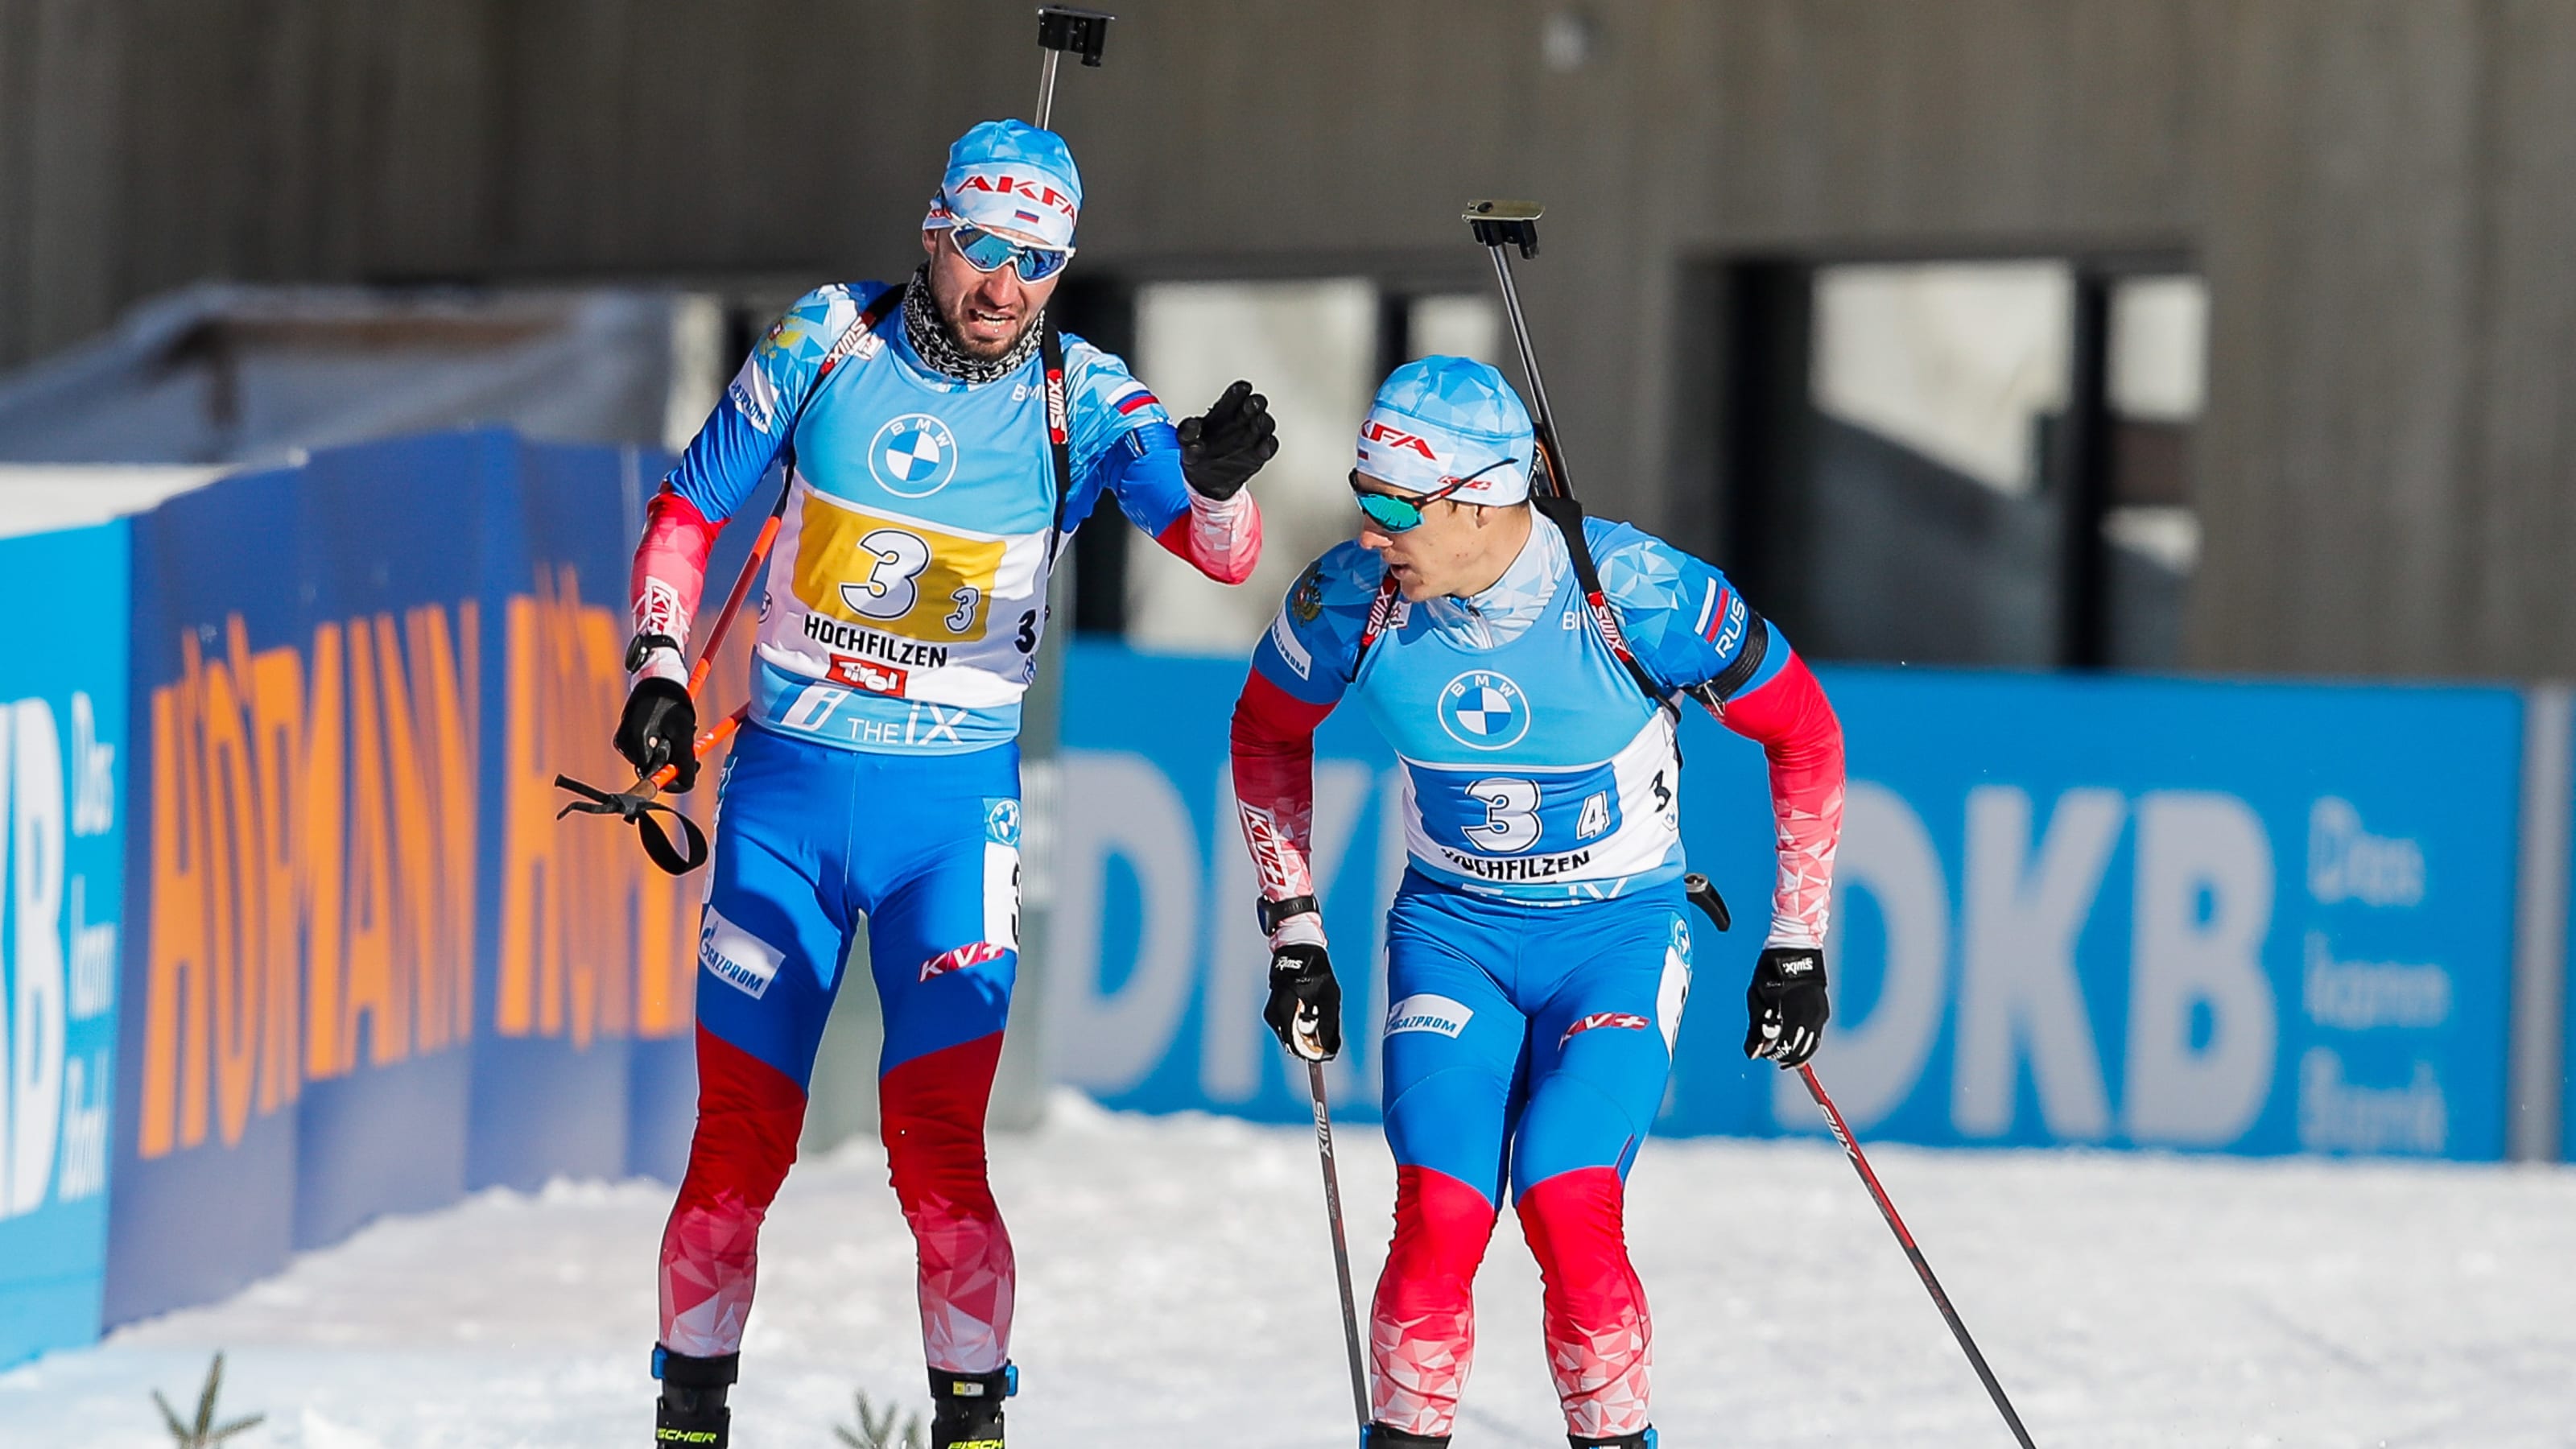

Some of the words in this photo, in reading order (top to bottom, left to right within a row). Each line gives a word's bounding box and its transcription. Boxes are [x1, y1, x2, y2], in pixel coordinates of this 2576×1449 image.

[955, 175, 1076, 227] AKFA
[1012, 383, 1046, 402] BM
[1047, 377, 1065, 429] SWIX
[890, 418, 952, 448] BMW
[840, 529, 932, 619] 3
[945, 587, 979, 632] 3
[1013, 608, 1037, 654] 3
[1367, 585, 1392, 638] SWIX
[1591, 605, 1628, 654] SWIX
[1714, 597, 1746, 659] RUS
[804, 613, 948, 668] HOCHFILZEN
[1450, 674, 1515, 698] BMW
[847, 717, 899, 745] THE
[1461, 778, 1543, 853] 3
[1576, 790, 1611, 840] 4
[707, 947, 765, 992] GAZPROM
[1773, 778, 2277, 1147] DKB
[1315, 1100, 1331, 1158] SWIX
